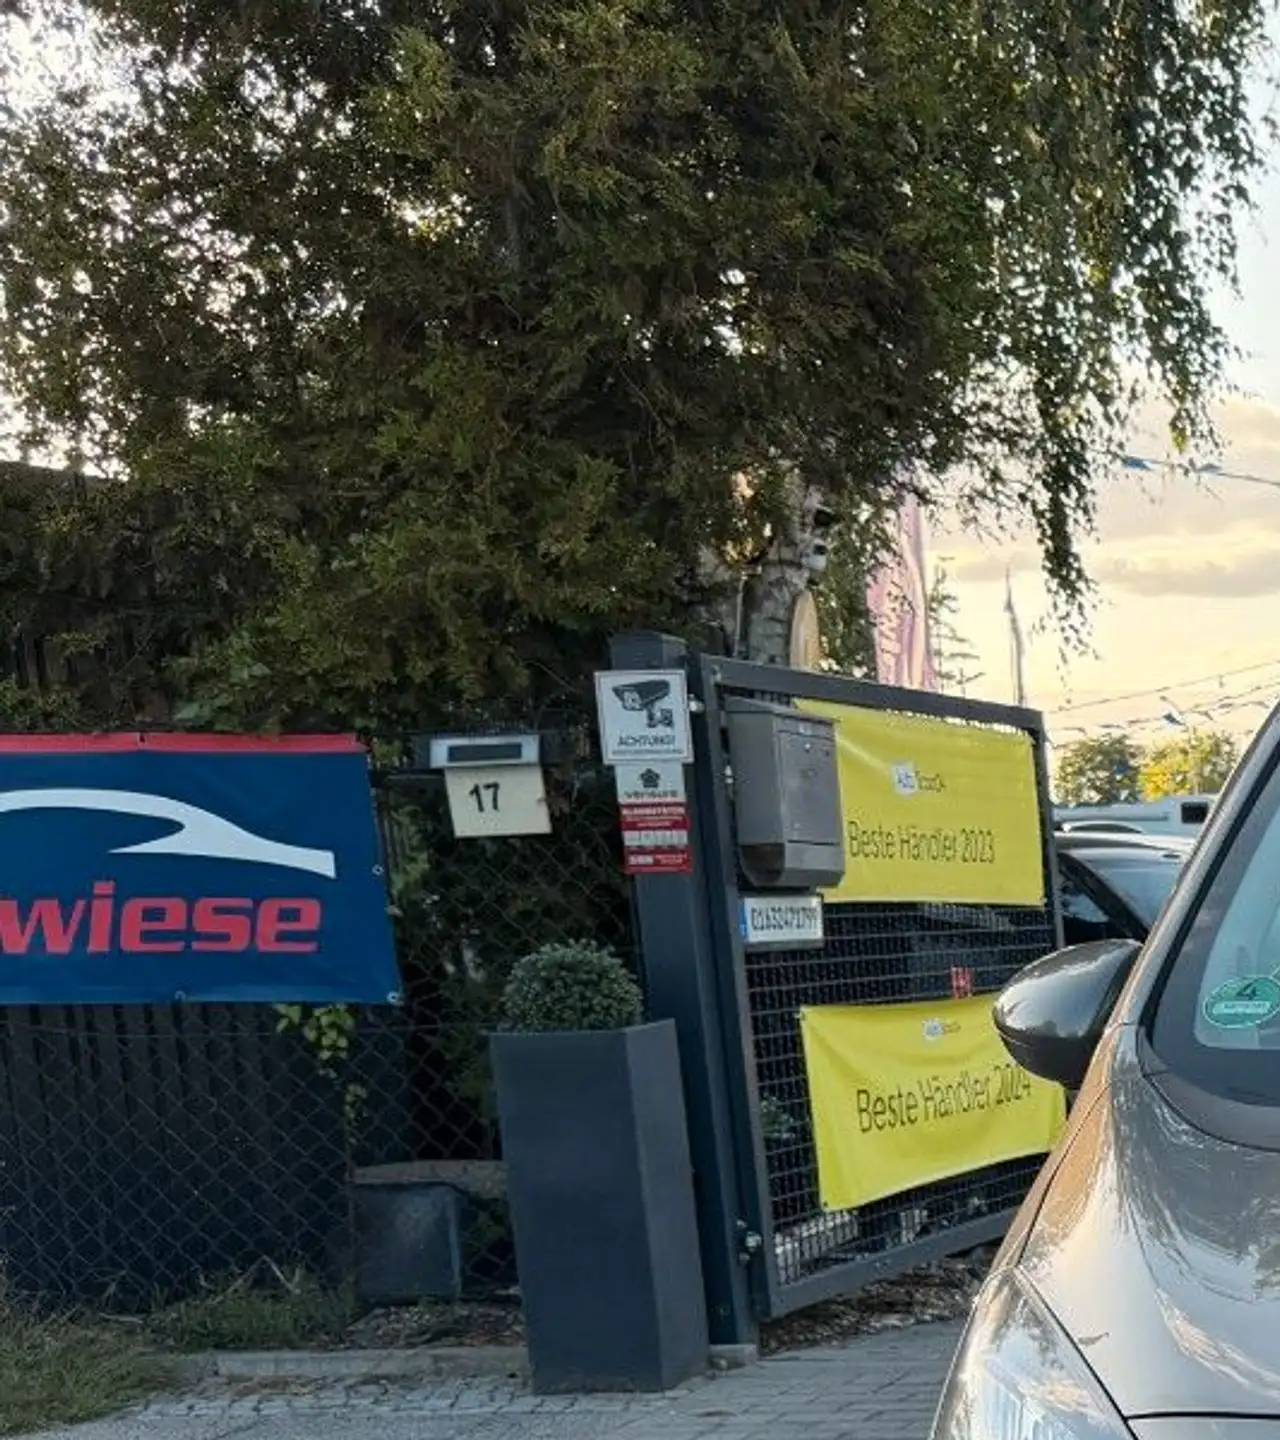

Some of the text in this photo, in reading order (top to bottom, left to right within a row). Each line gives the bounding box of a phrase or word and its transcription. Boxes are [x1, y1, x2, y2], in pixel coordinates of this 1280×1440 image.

[468, 782, 500, 812] 17
[848, 820, 995, 865] Beste Händler 2023
[0, 880, 321, 954] wiese
[856, 1062, 1032, 1134] Beste Händler 2024
